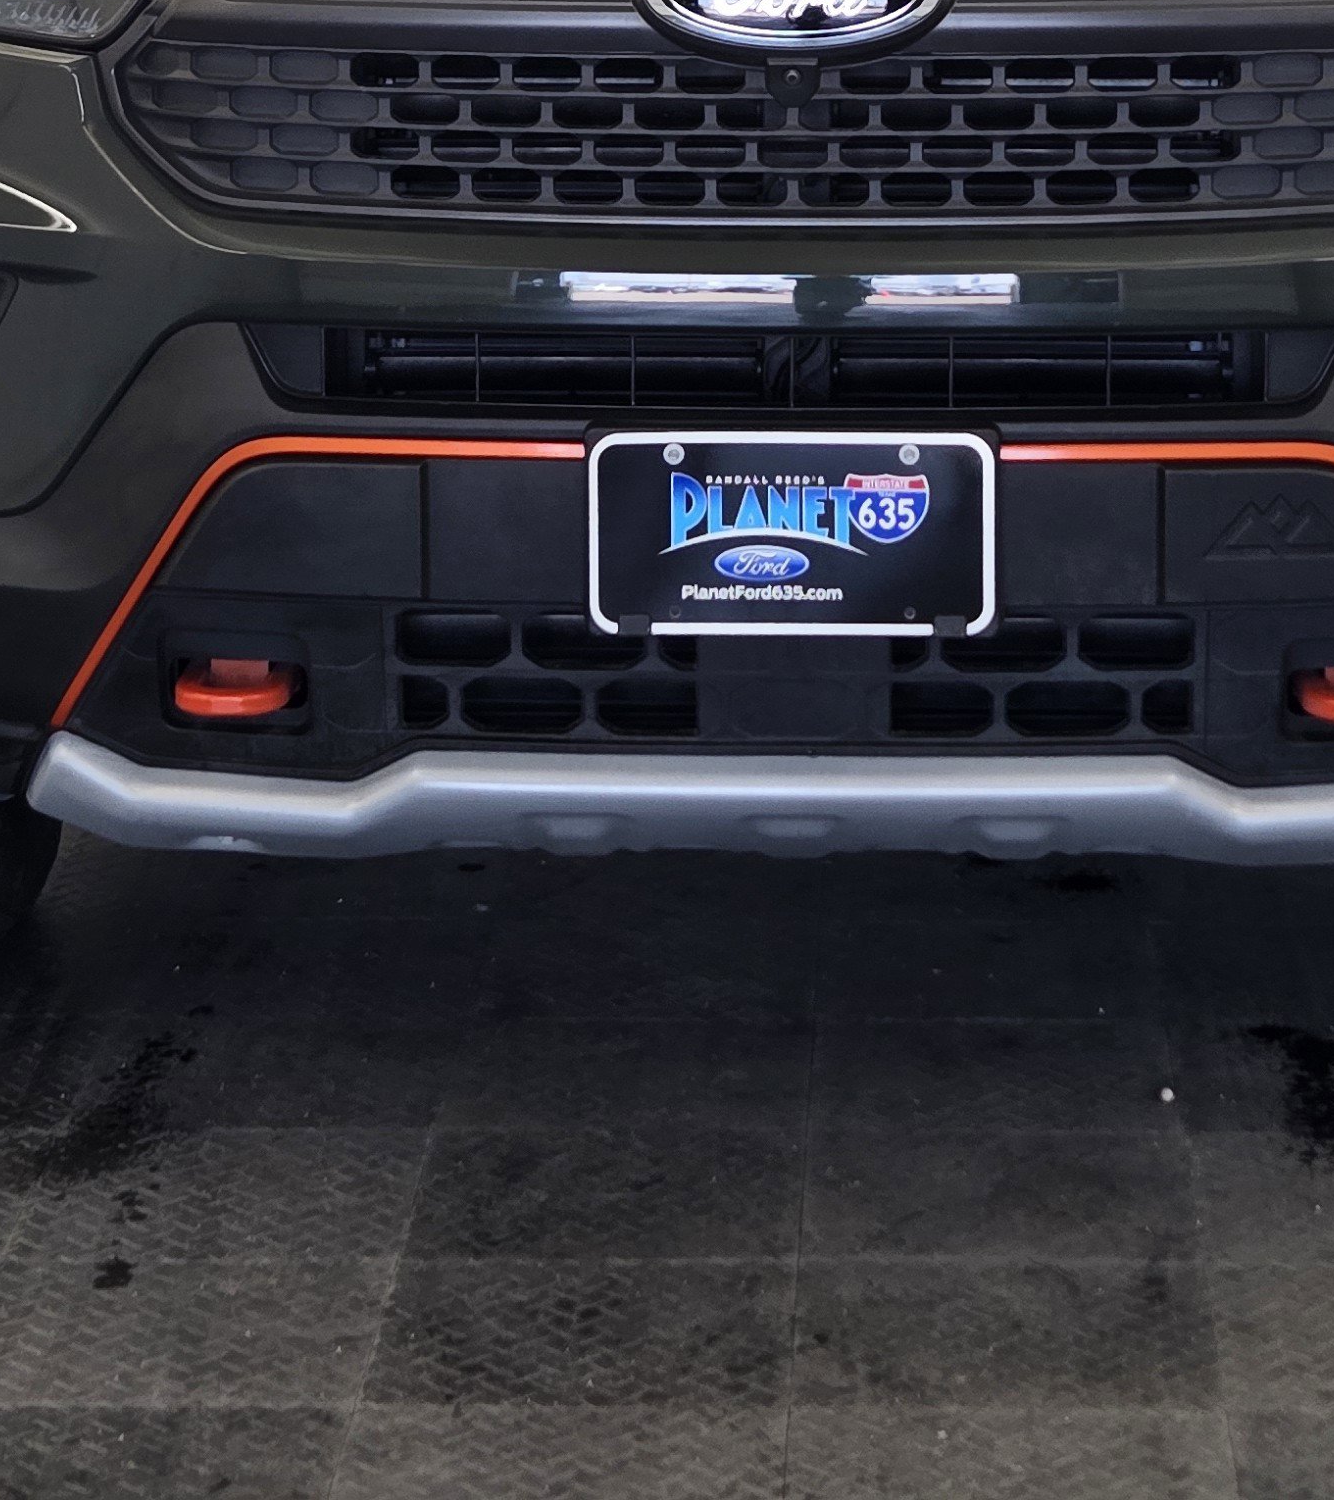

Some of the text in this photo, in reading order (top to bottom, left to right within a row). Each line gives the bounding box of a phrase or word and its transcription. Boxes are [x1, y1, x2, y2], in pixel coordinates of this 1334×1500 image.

[670, 471, 856, 548] PLANET
[858, 497, 916, 531] 635
[733, 550, 791, 578] Ford
[681, 583, 844, 601] PlanetFord635.com
